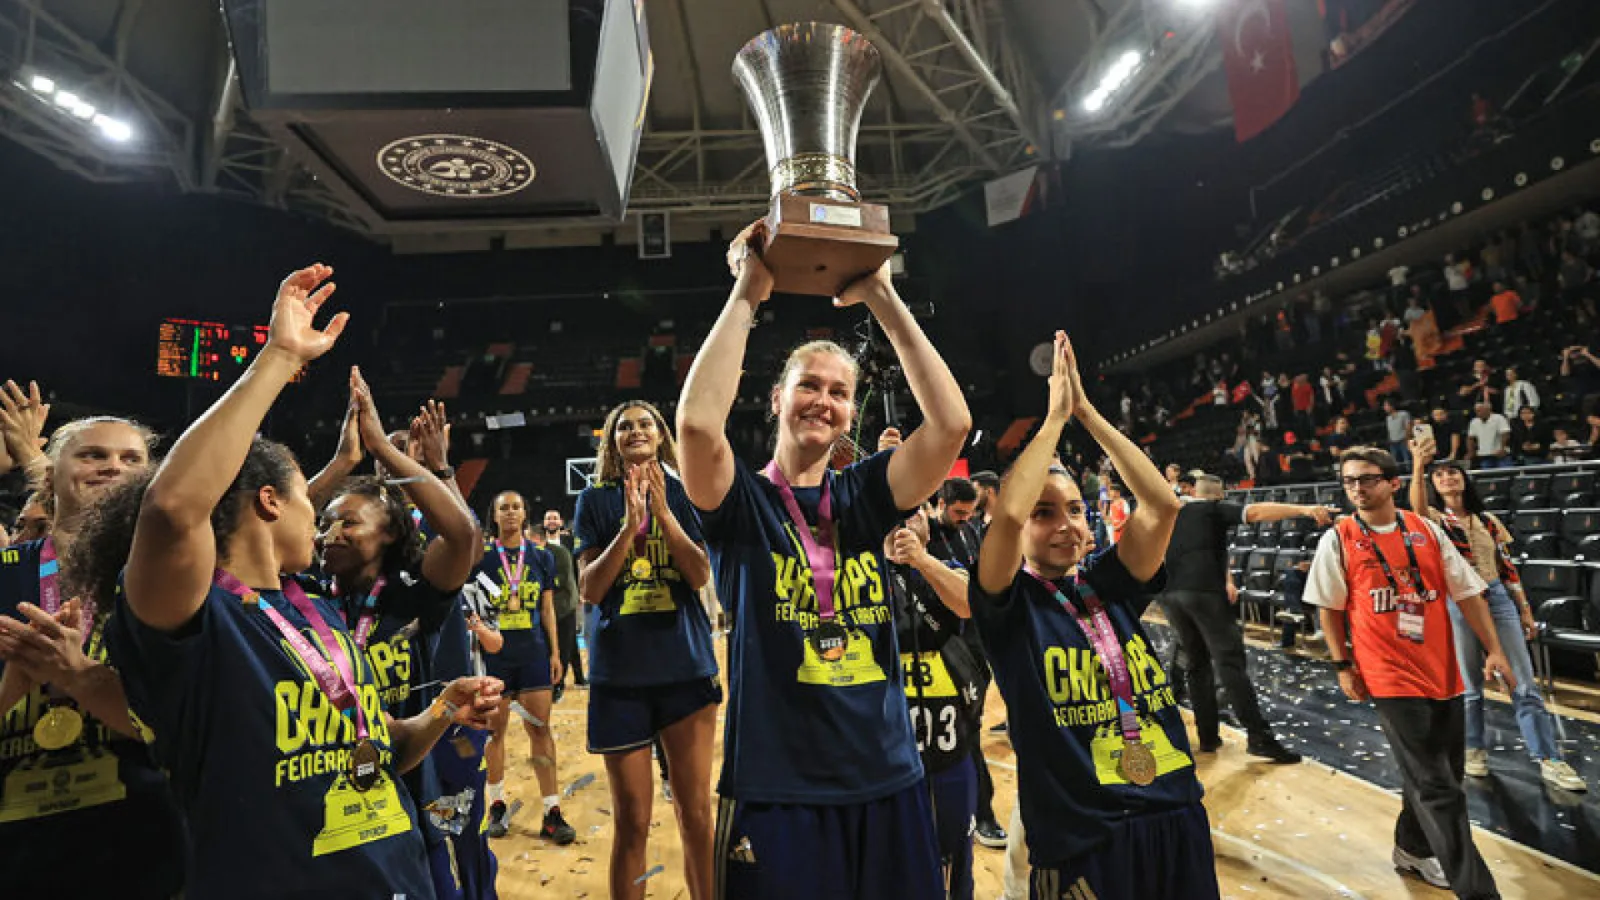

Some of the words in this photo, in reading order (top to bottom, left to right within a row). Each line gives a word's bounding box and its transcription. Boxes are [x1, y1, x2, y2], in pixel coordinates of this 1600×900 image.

[770, 551, 885, 611] CHAPS
[1044, 634, 1166, 703] CHAPS
[274, 681, 391, 753] CHAPS
